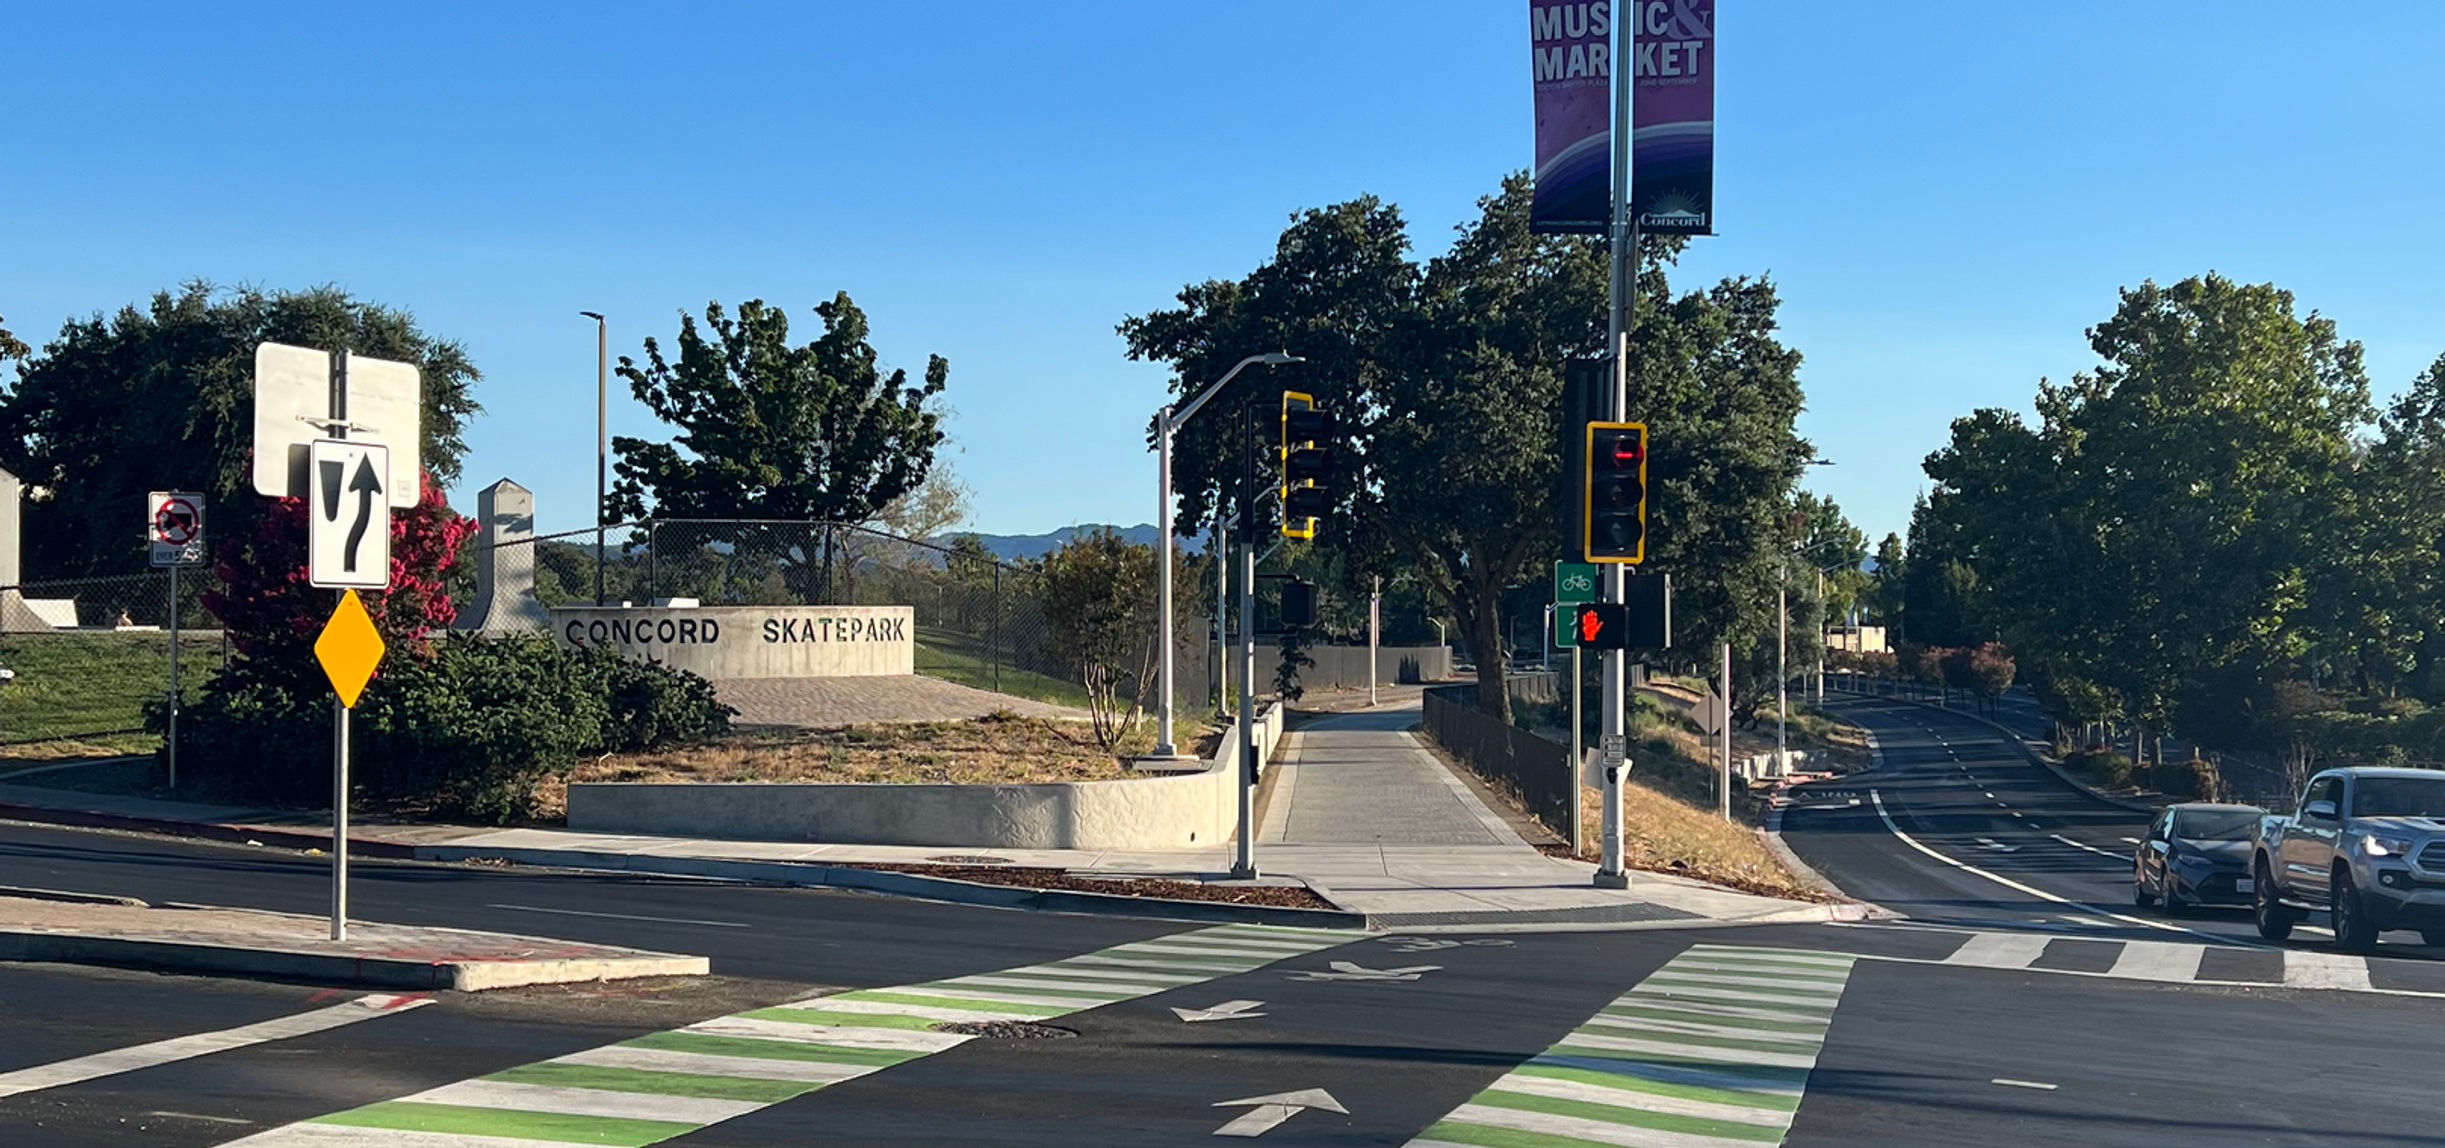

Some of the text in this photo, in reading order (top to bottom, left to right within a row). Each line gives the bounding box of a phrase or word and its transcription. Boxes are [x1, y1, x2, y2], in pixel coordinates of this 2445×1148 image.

[1640, 212, 1706, 227] Concord
[565, 617, 905, 646] CONCORD SKATEPARK
